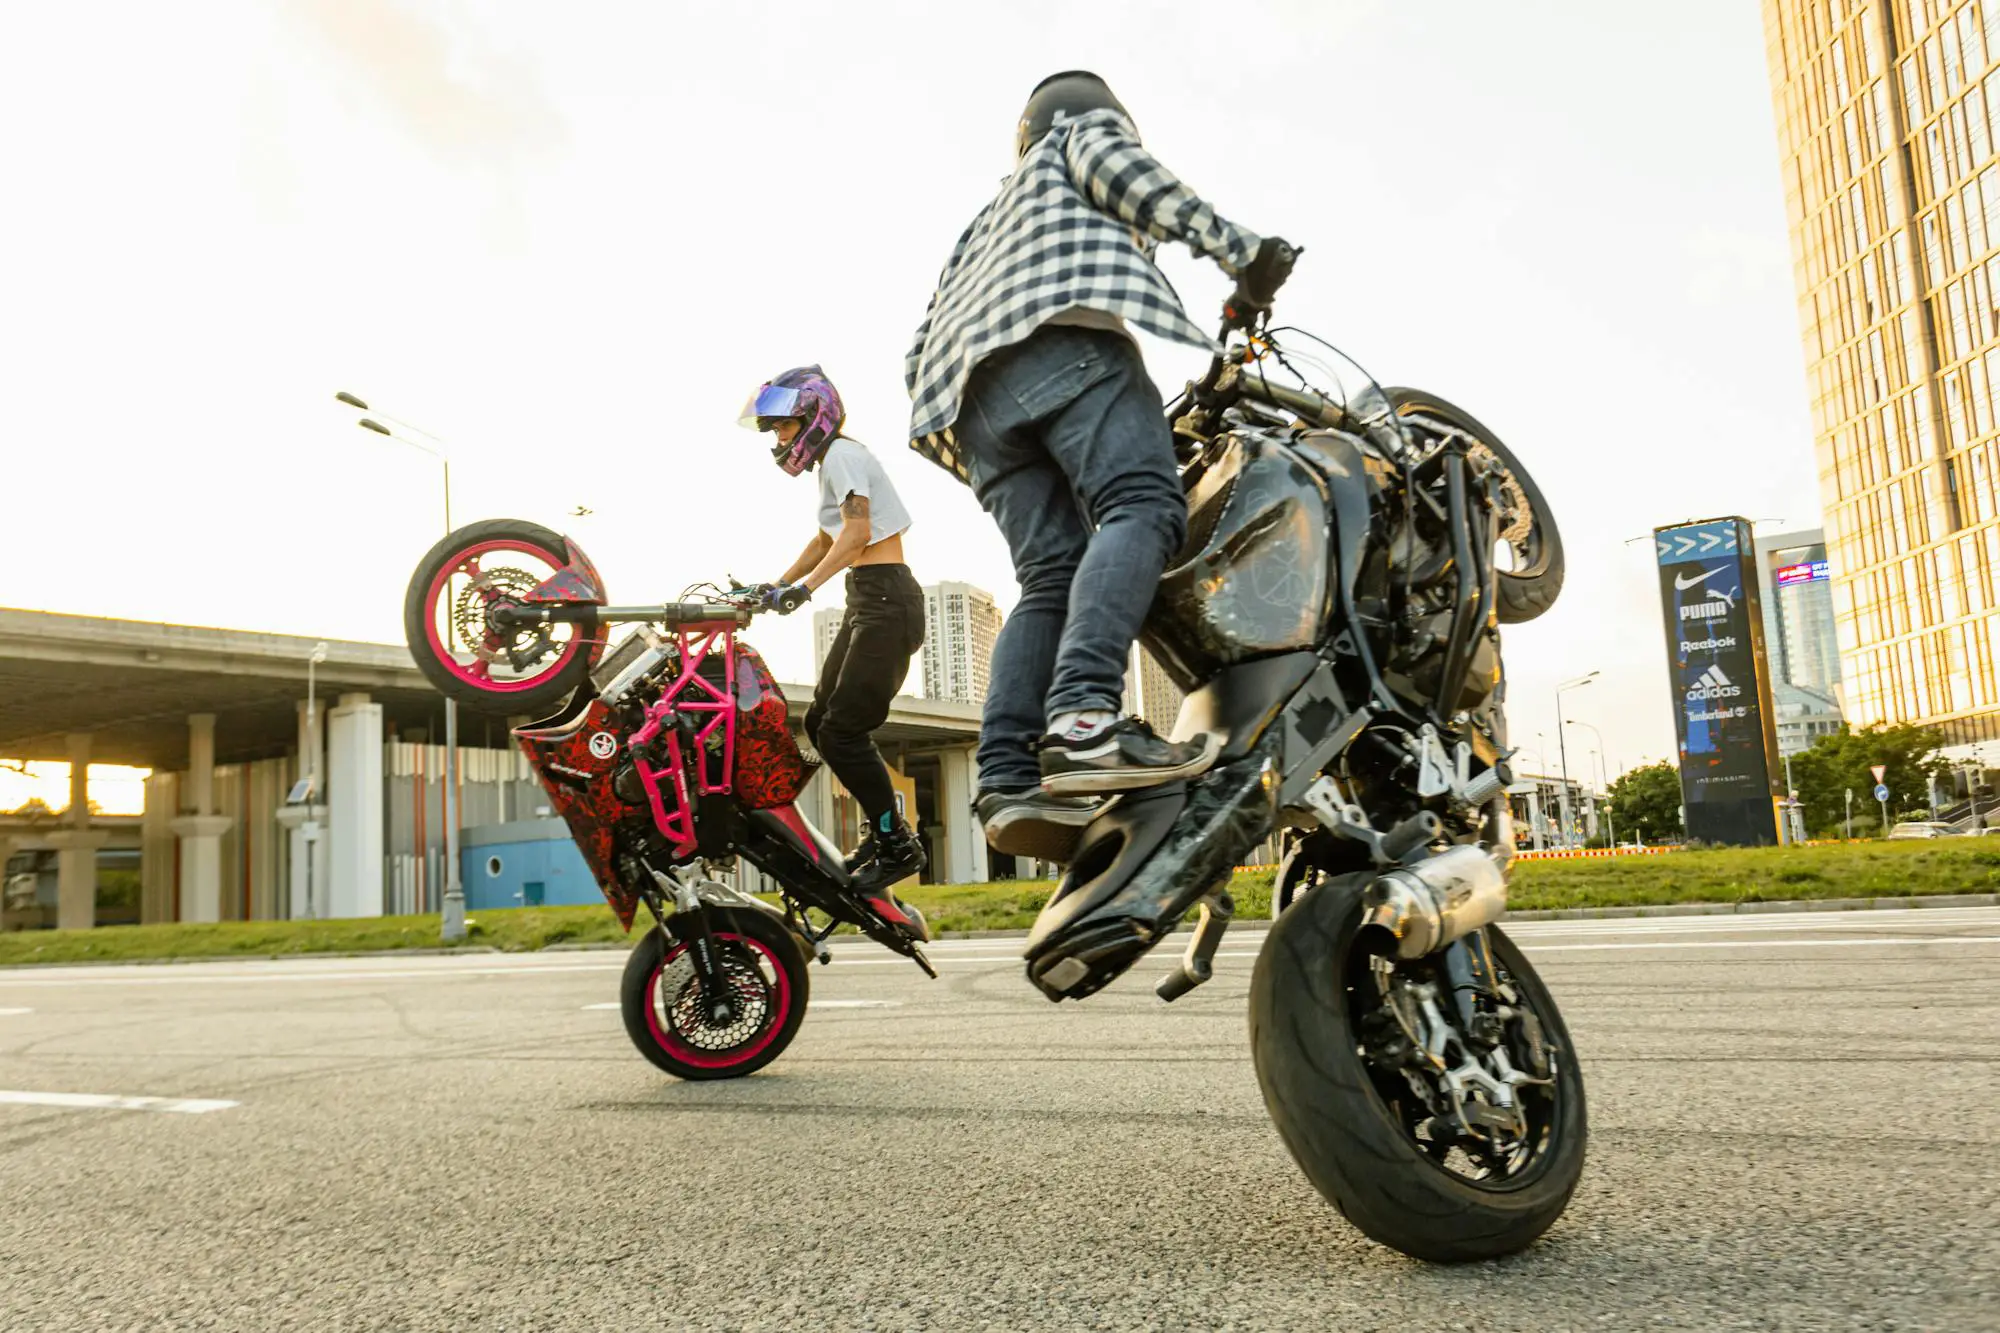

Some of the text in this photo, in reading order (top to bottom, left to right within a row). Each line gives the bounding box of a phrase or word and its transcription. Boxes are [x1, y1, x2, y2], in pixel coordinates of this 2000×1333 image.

[1680, 601, 1727, 620] PUMA
[1680, 636, 1736, 653] Reebok
[1686, 686, 1741, 700] adidas
[1687, 708, 1734, 721] Timberland
